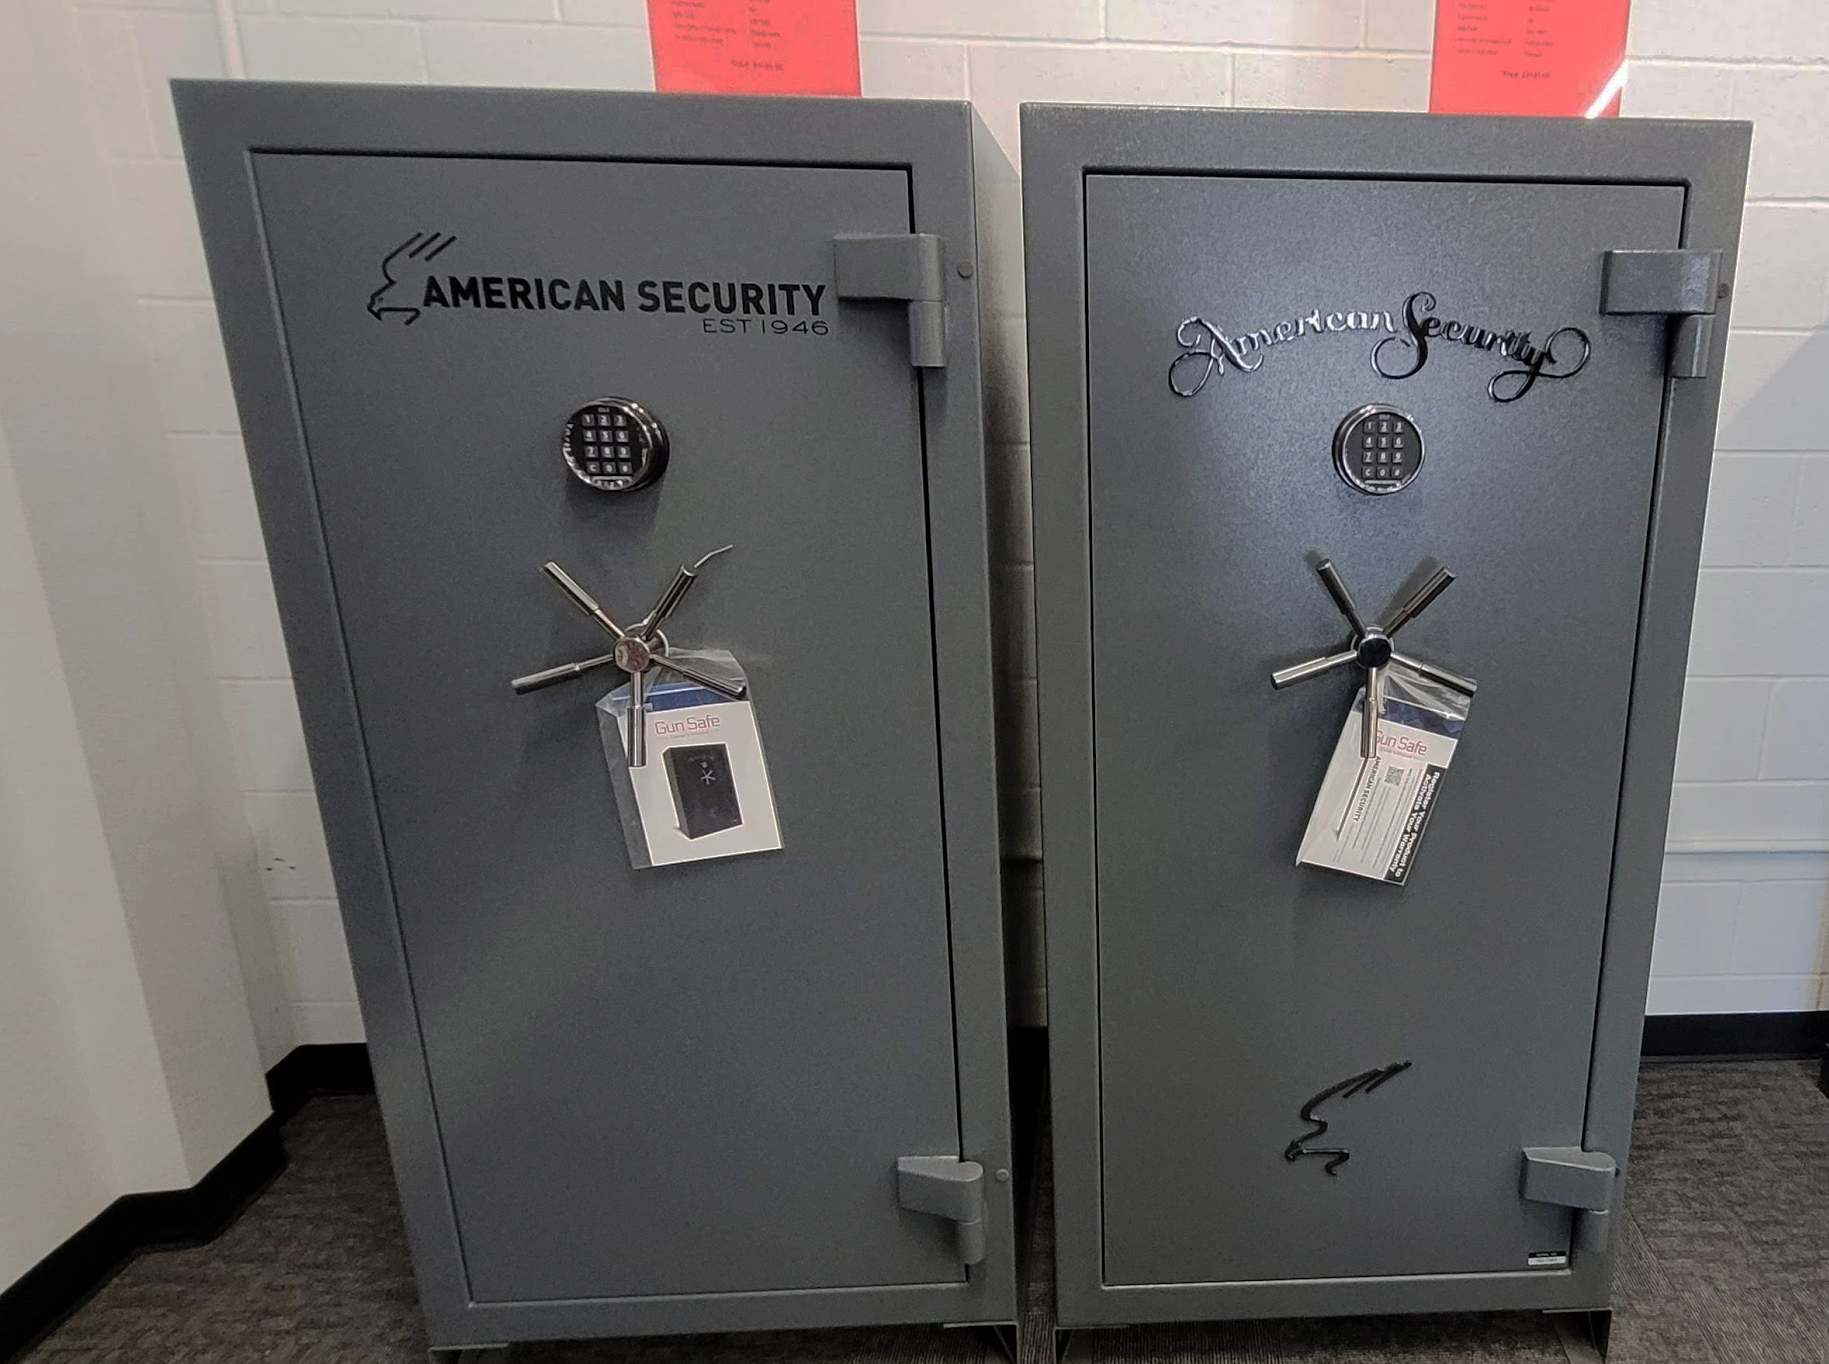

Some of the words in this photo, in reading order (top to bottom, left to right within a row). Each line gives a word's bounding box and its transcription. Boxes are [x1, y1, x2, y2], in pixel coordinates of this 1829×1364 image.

[422, 275, 625, 312] AMERICAN
[637, 279, 827, 317] SECURITY
[703, 318, 752, 334] EST
[761, 319, 830, 337] 1946
[1168, 308, 1397, 397] American
[1371, 291, 1591, 403] Security
[655, 721, 685, 734] Gun
[686, 714, 721, 730] Safe
[1397, 736, 1428, 756] Safe
[1366, 756, 1381, 789] AMERICAN
[1353, 789, 1369, 822] SECURITY
[1413, 773, 1432, 811] Activate
[1421, 771, 1440, 810] Register
[1406, 812, 1418, 833] Your
[1413, 811, 1426, 832] Your
[1399, 832, 1418, 868] Product
[1394, 867, 1404, 878] to
